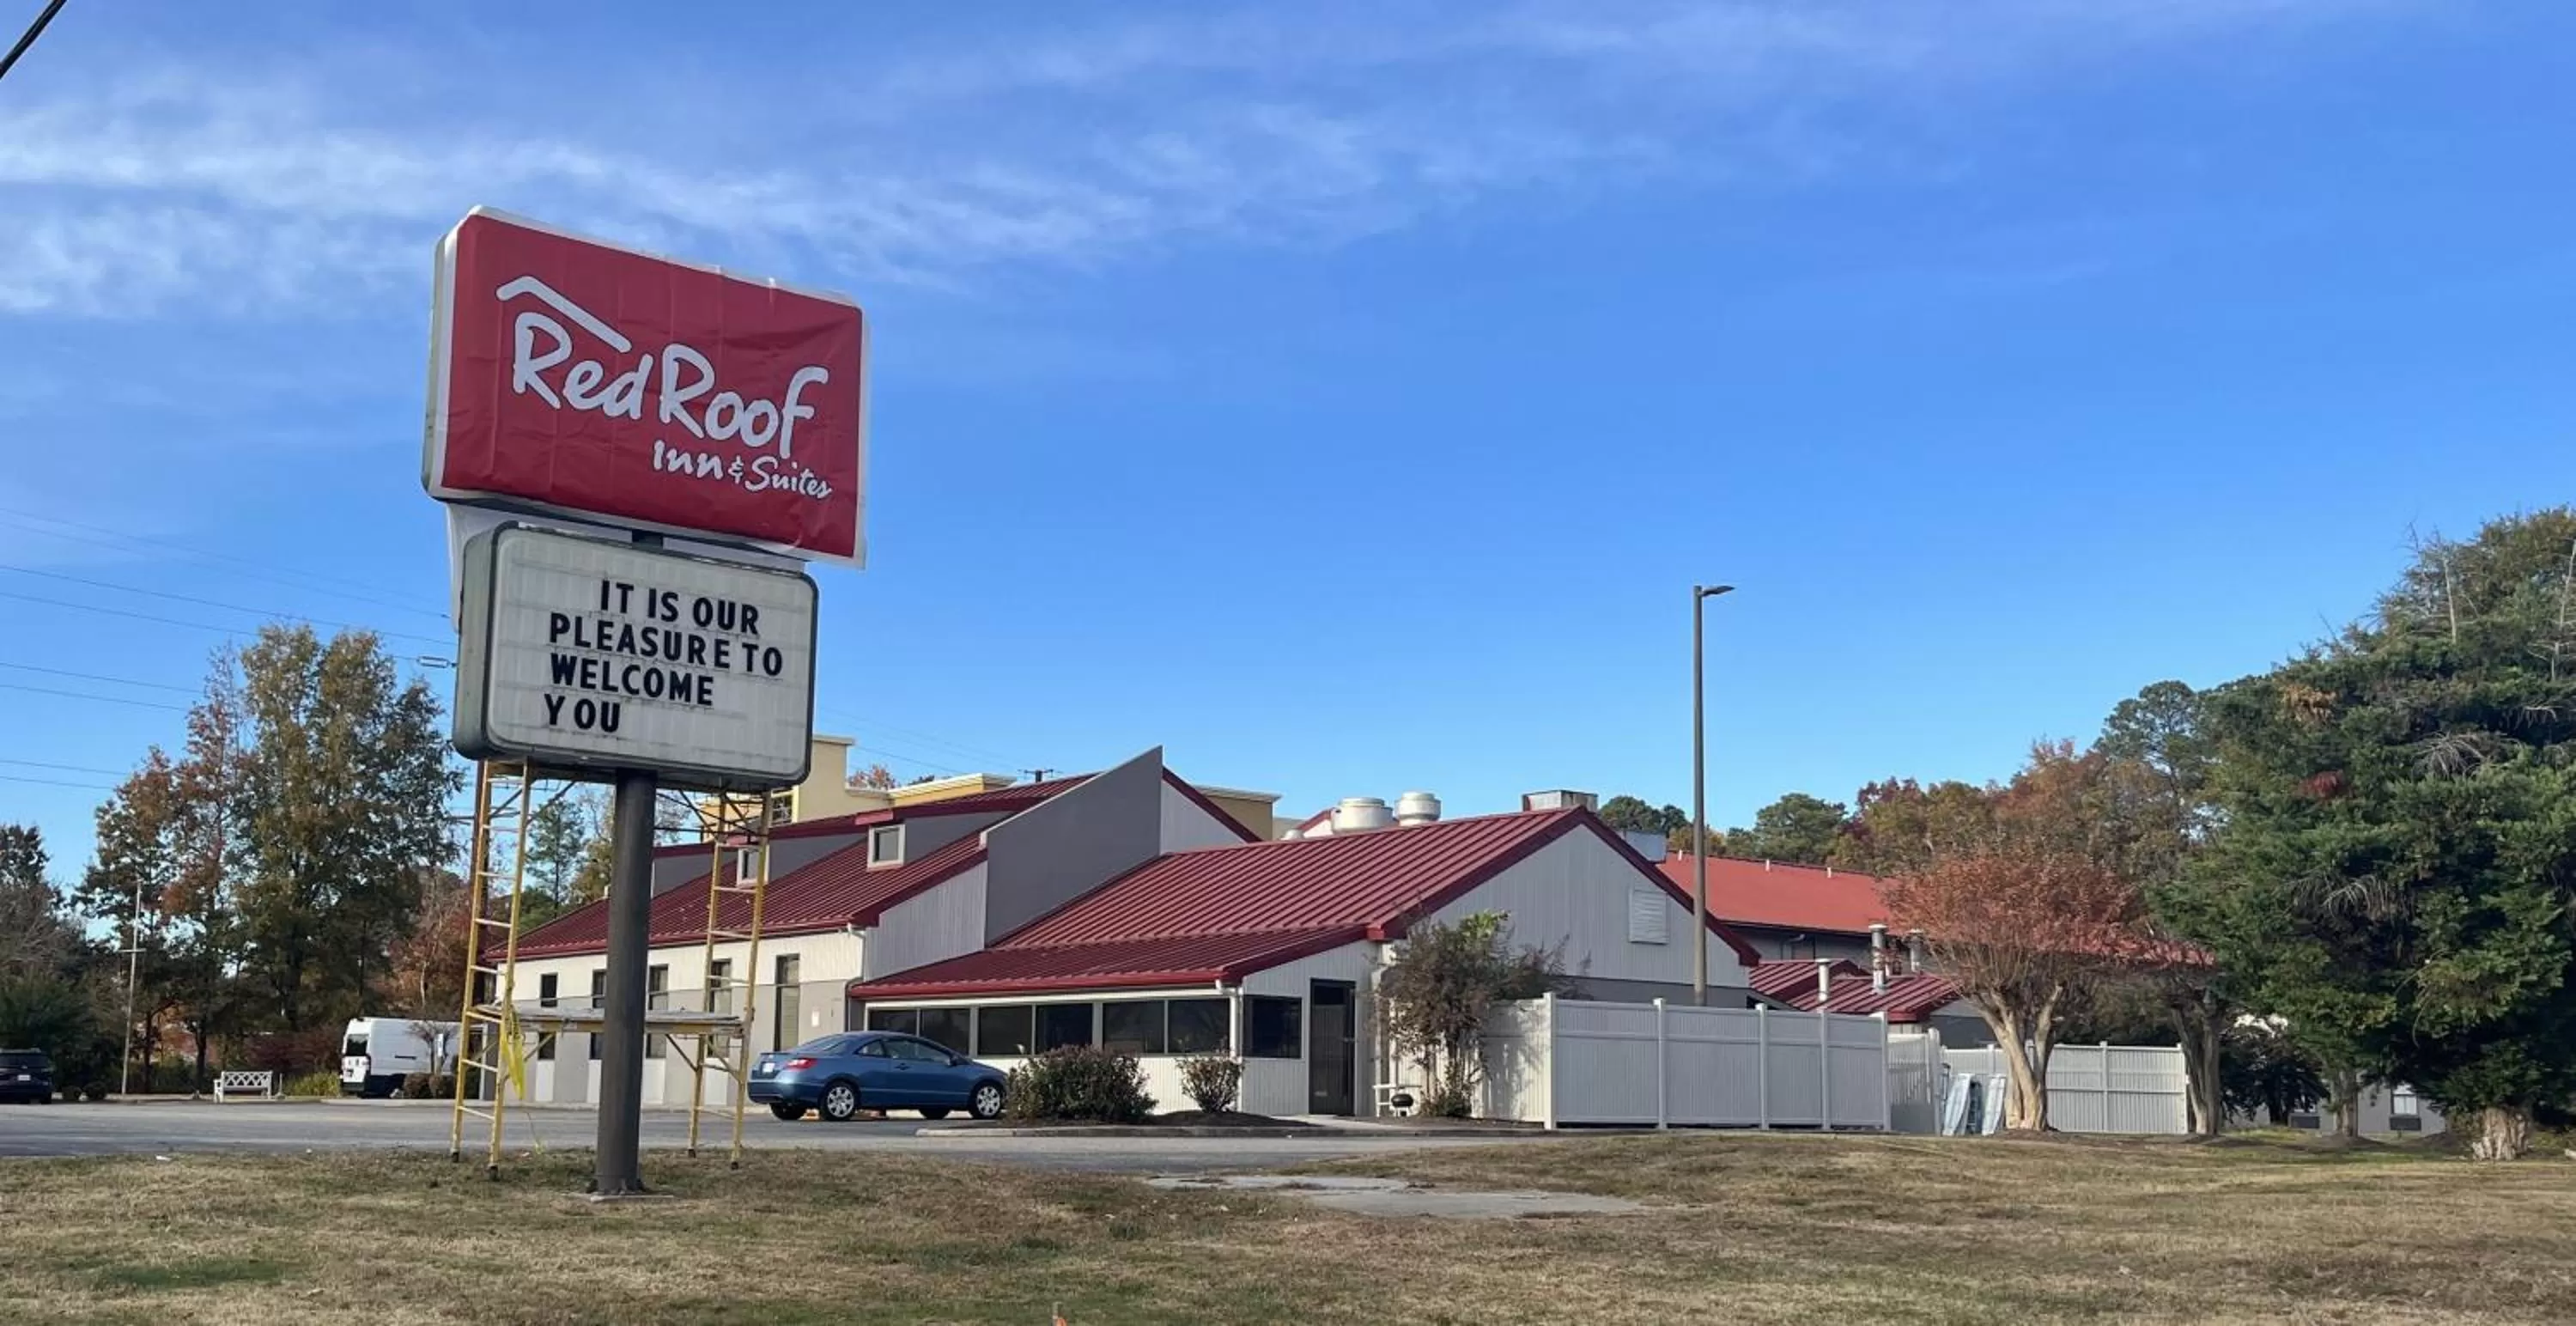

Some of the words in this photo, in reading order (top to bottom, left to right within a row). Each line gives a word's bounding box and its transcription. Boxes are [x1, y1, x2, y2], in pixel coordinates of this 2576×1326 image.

[653, 440, 725, 481] Inn
[728, 455, 745, 484] &
[744, 457, 833, 500] Suites
[600, 579, 635, 613] IT
[647, 588, 679, 623] IS
[692, 596, 759, 635] OUR
[549, 612, 731, 669] PLEASURE
[741, 642, 783, 677] TO
[550, 652, 714, 706] WELCOME
[544, 693, 622, 733] YOU
